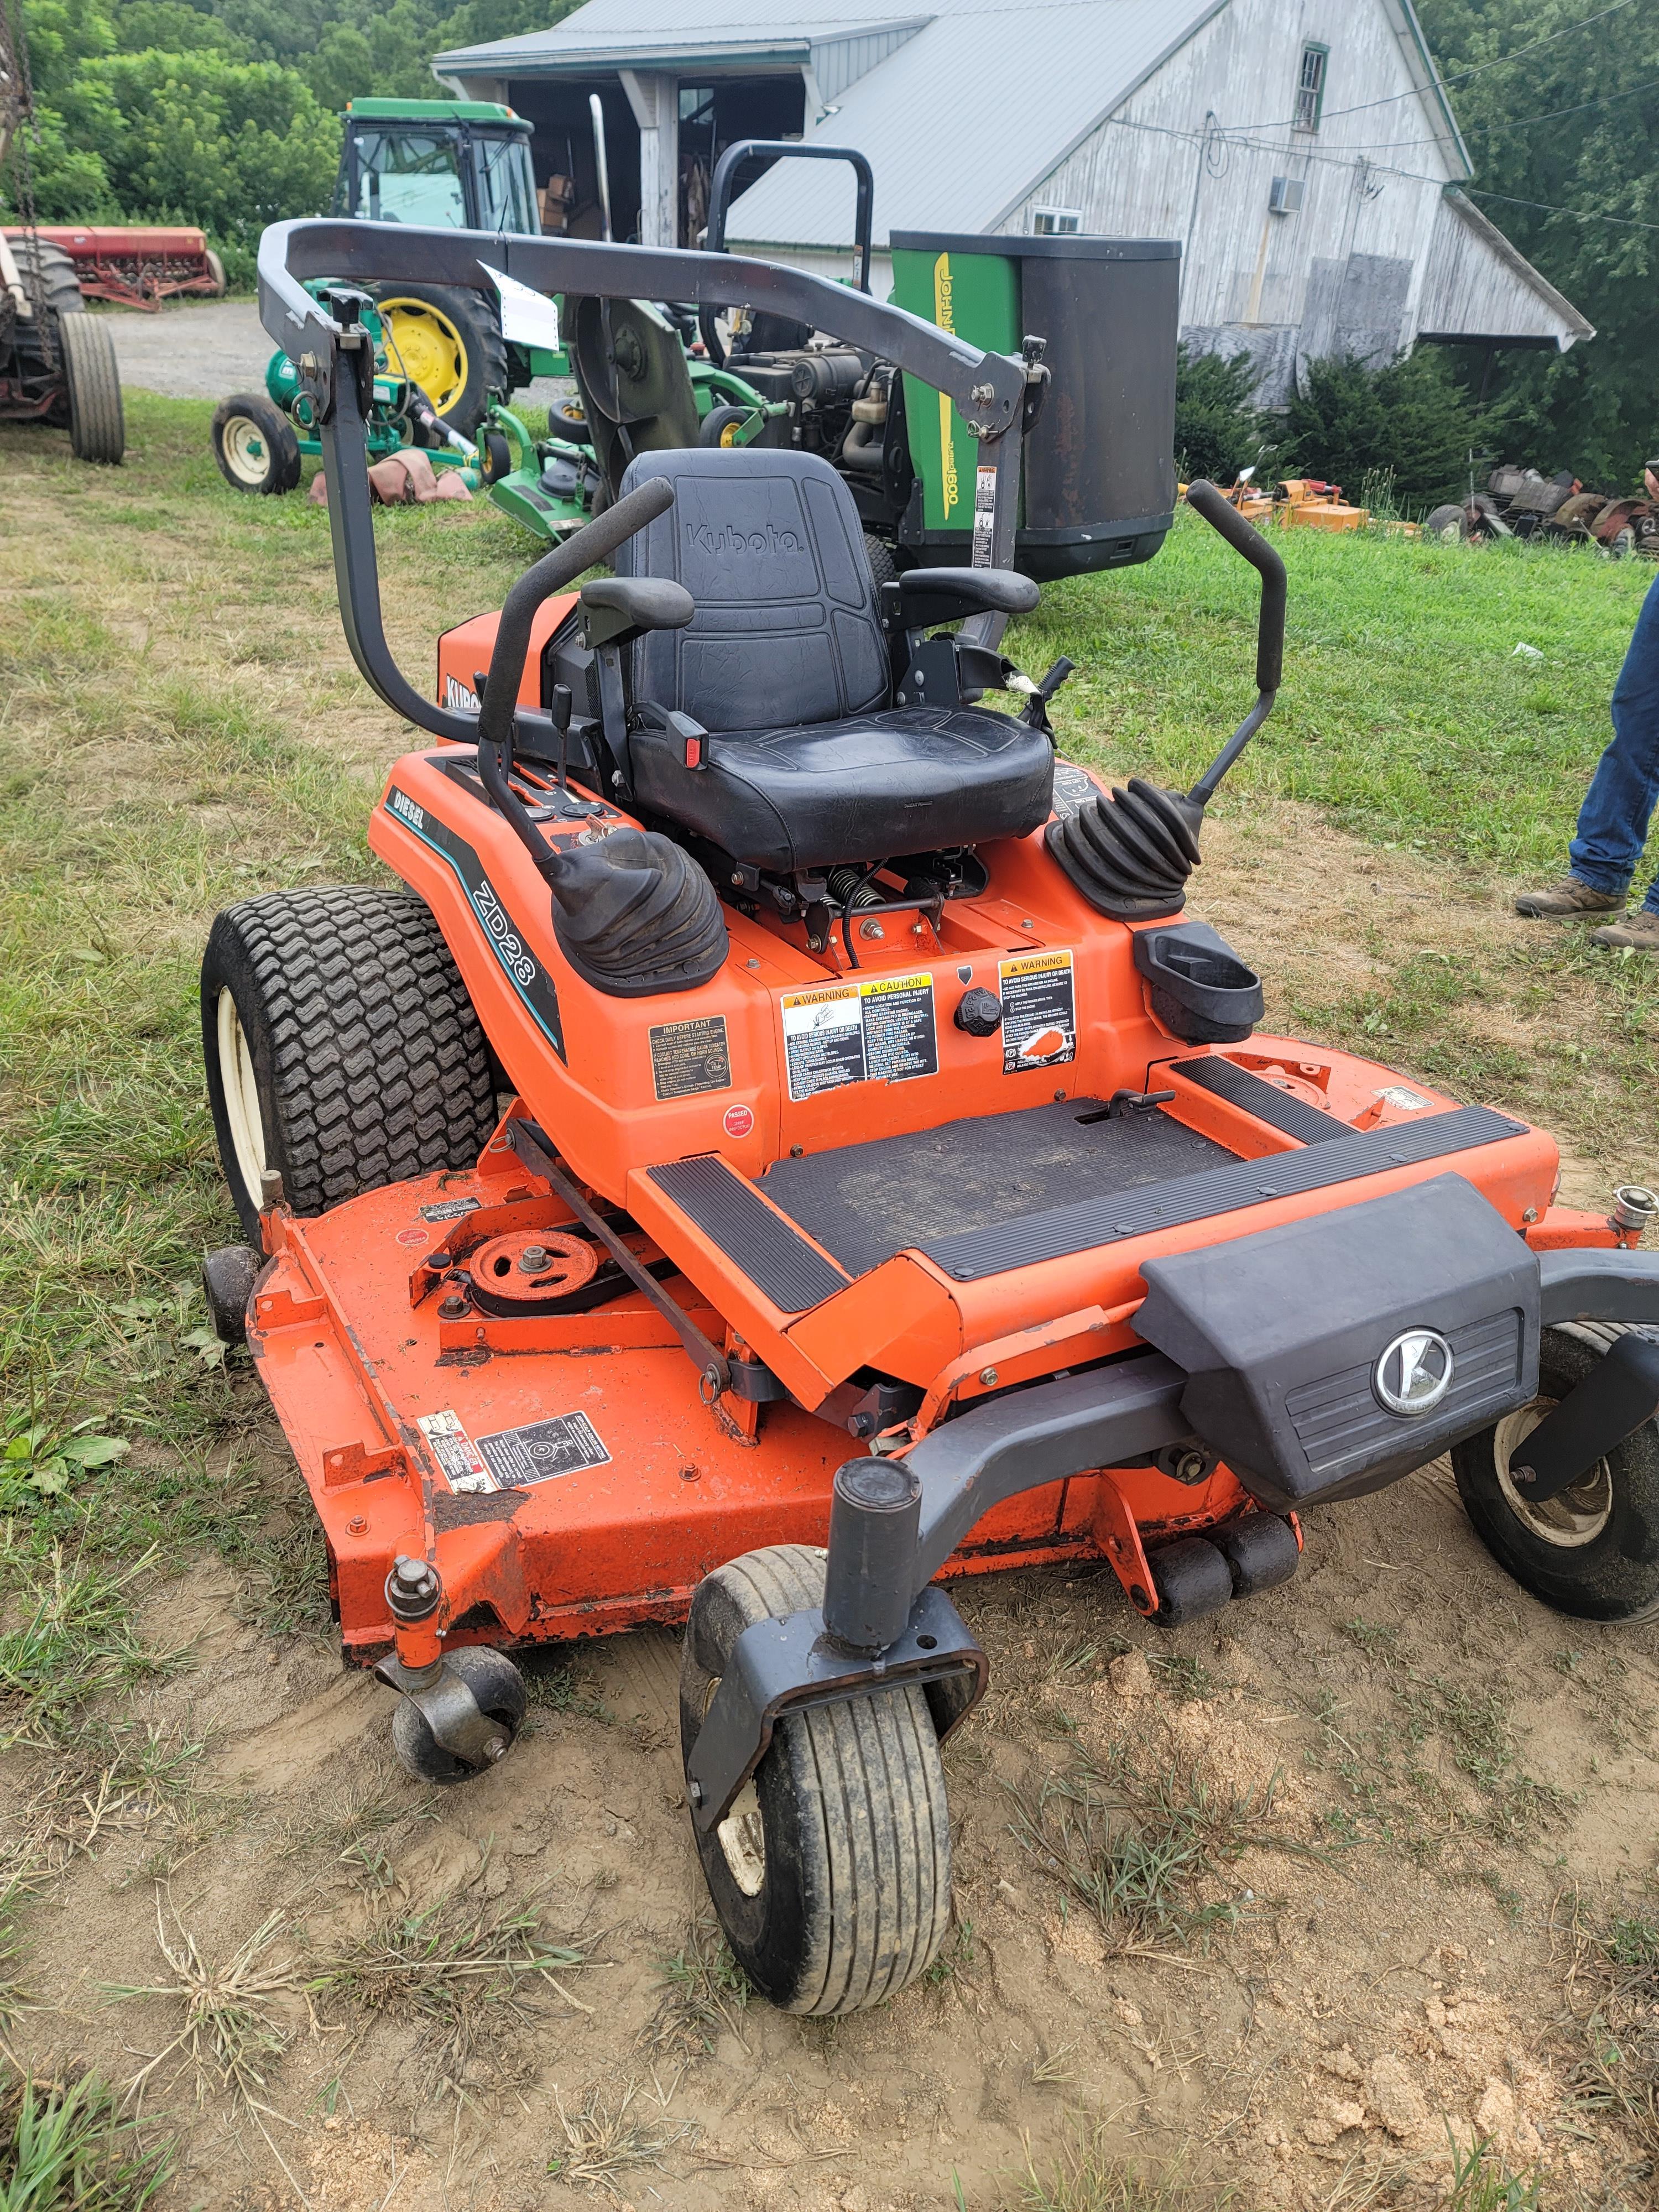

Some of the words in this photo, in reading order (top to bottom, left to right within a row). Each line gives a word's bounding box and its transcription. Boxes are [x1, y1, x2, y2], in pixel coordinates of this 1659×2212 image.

[940, 268, 953, 328] JOHN
[947, 468, 958, 505] 1600
[686, 524, 800, 555] Kubota
[446, 673, 482, 708] KUBO
[394, 792, 423, 830] DIESEL
[473, 880, 535, 985] ZD28
[1021, 956, 1062, 971] WARNING
[880, 977, 921, 992] CAUTION
[802, 989, 849, 1004] WARNING
[887, 991, 912, 1000] PERSONAL
[663, 1019, 711, 1034] IMPORTANT
[673, 1046, 696, 1055] TEMPERATURE
[728, 1110, 748, 1119] PASSED
[460, 1442, 479, 1465] DANGER
